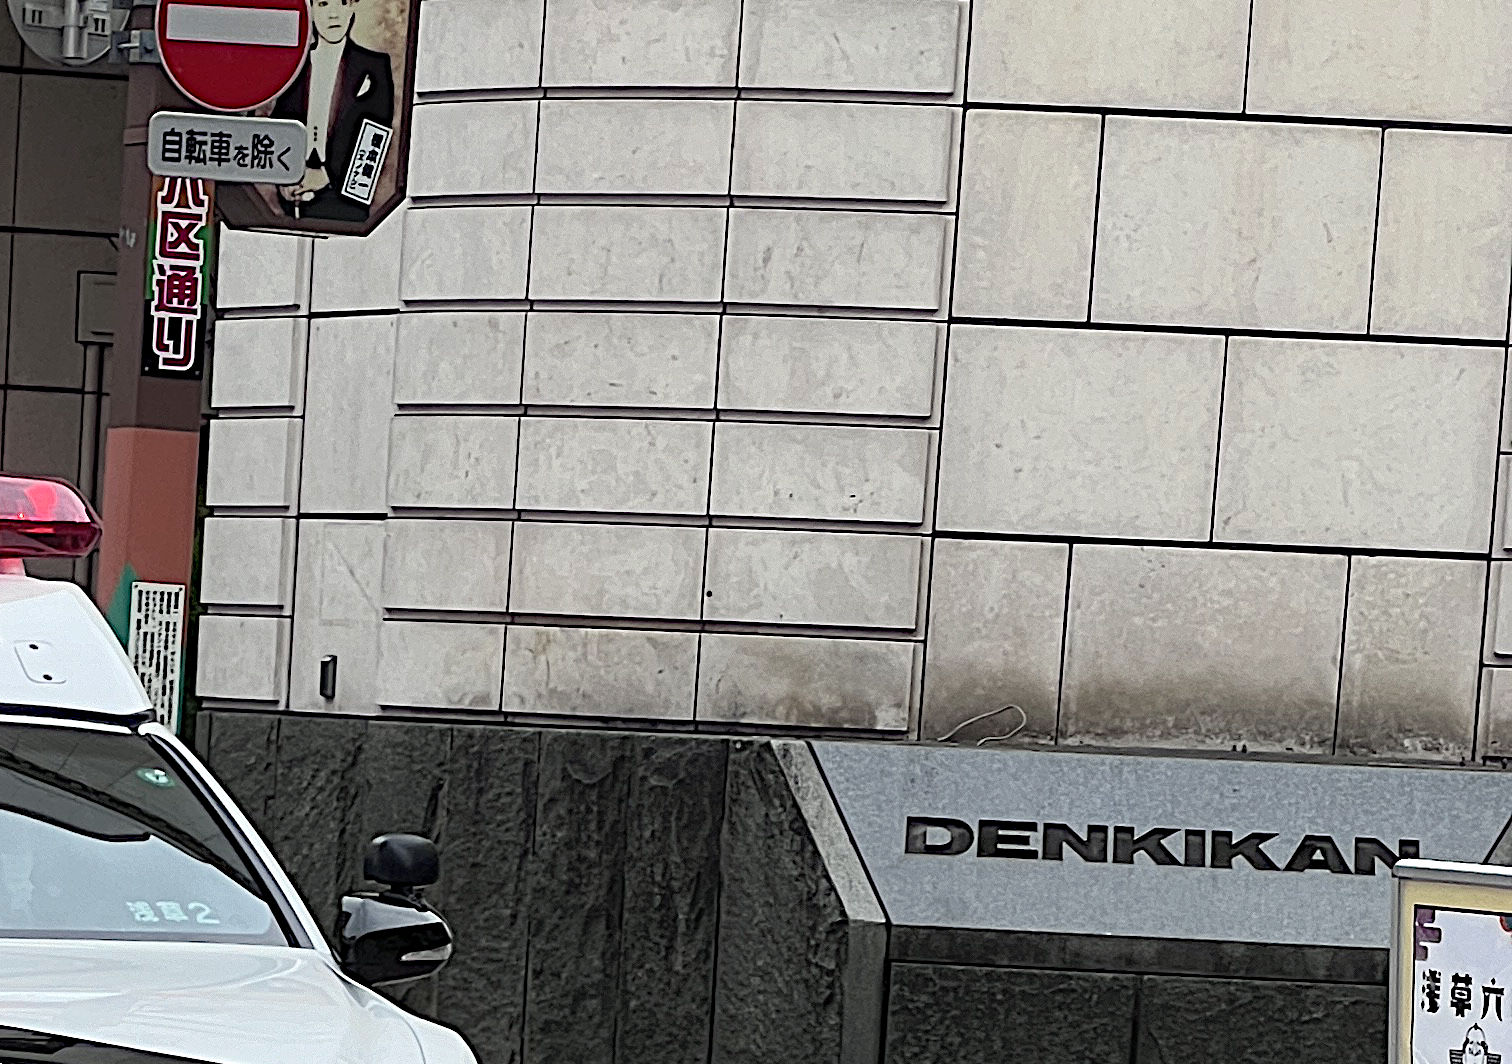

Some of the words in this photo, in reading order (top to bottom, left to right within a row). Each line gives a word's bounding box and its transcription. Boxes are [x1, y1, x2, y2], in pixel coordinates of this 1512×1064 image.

[161, 128, 291, 171] 自転車を除く
[904, 816, 1420, 876] DENKIKAN
